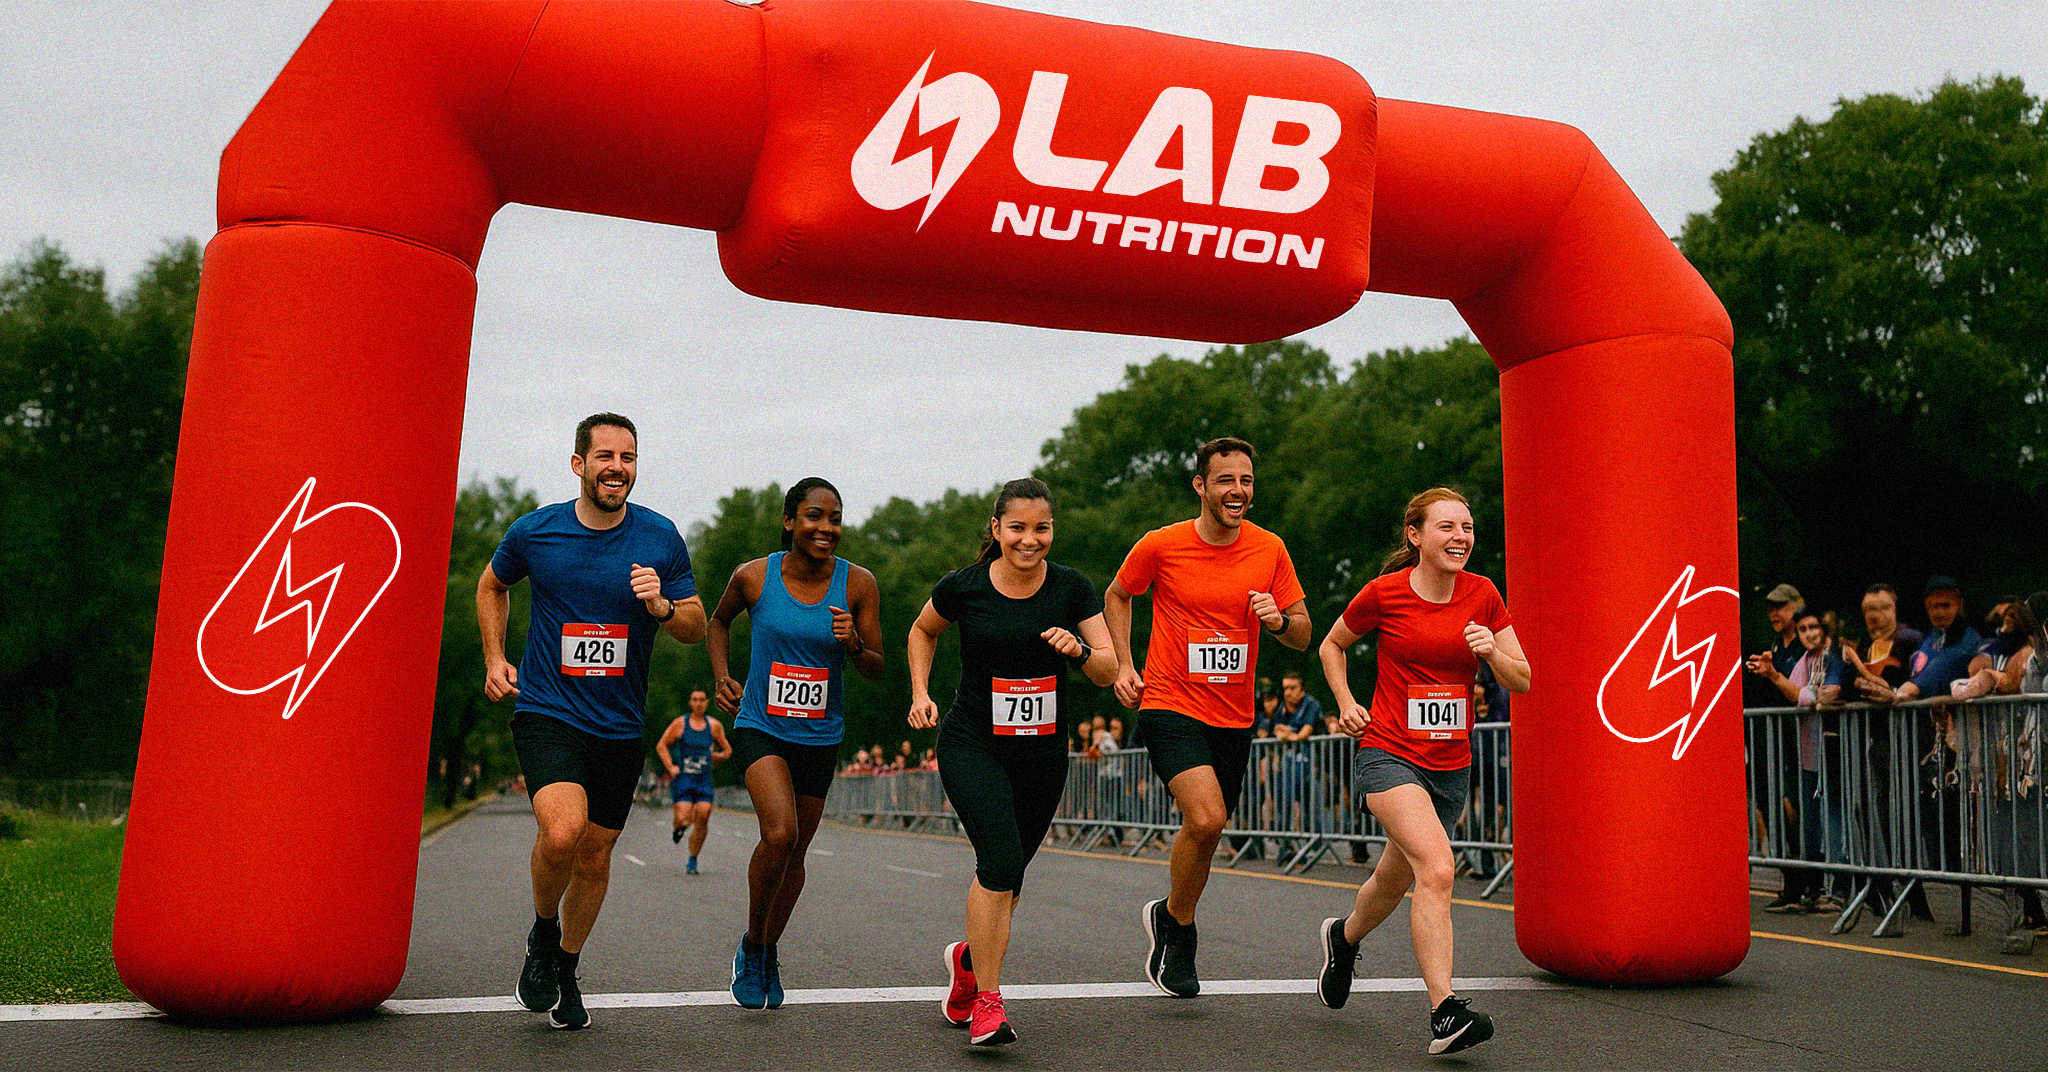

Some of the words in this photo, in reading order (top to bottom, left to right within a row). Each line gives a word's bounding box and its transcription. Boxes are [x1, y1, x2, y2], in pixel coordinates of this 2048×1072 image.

[1013, 70, 1341, 214] LAB
[991, 201, 1325, 269] NUTRITION
[574, 640, 615, 664] 426
[1199, 647, 1240, 670] 1139
[776, 680, 823, 706] 1203
[1005, 696, 1043, 722] 791
[1418, 702, 1457, 726] 1041
